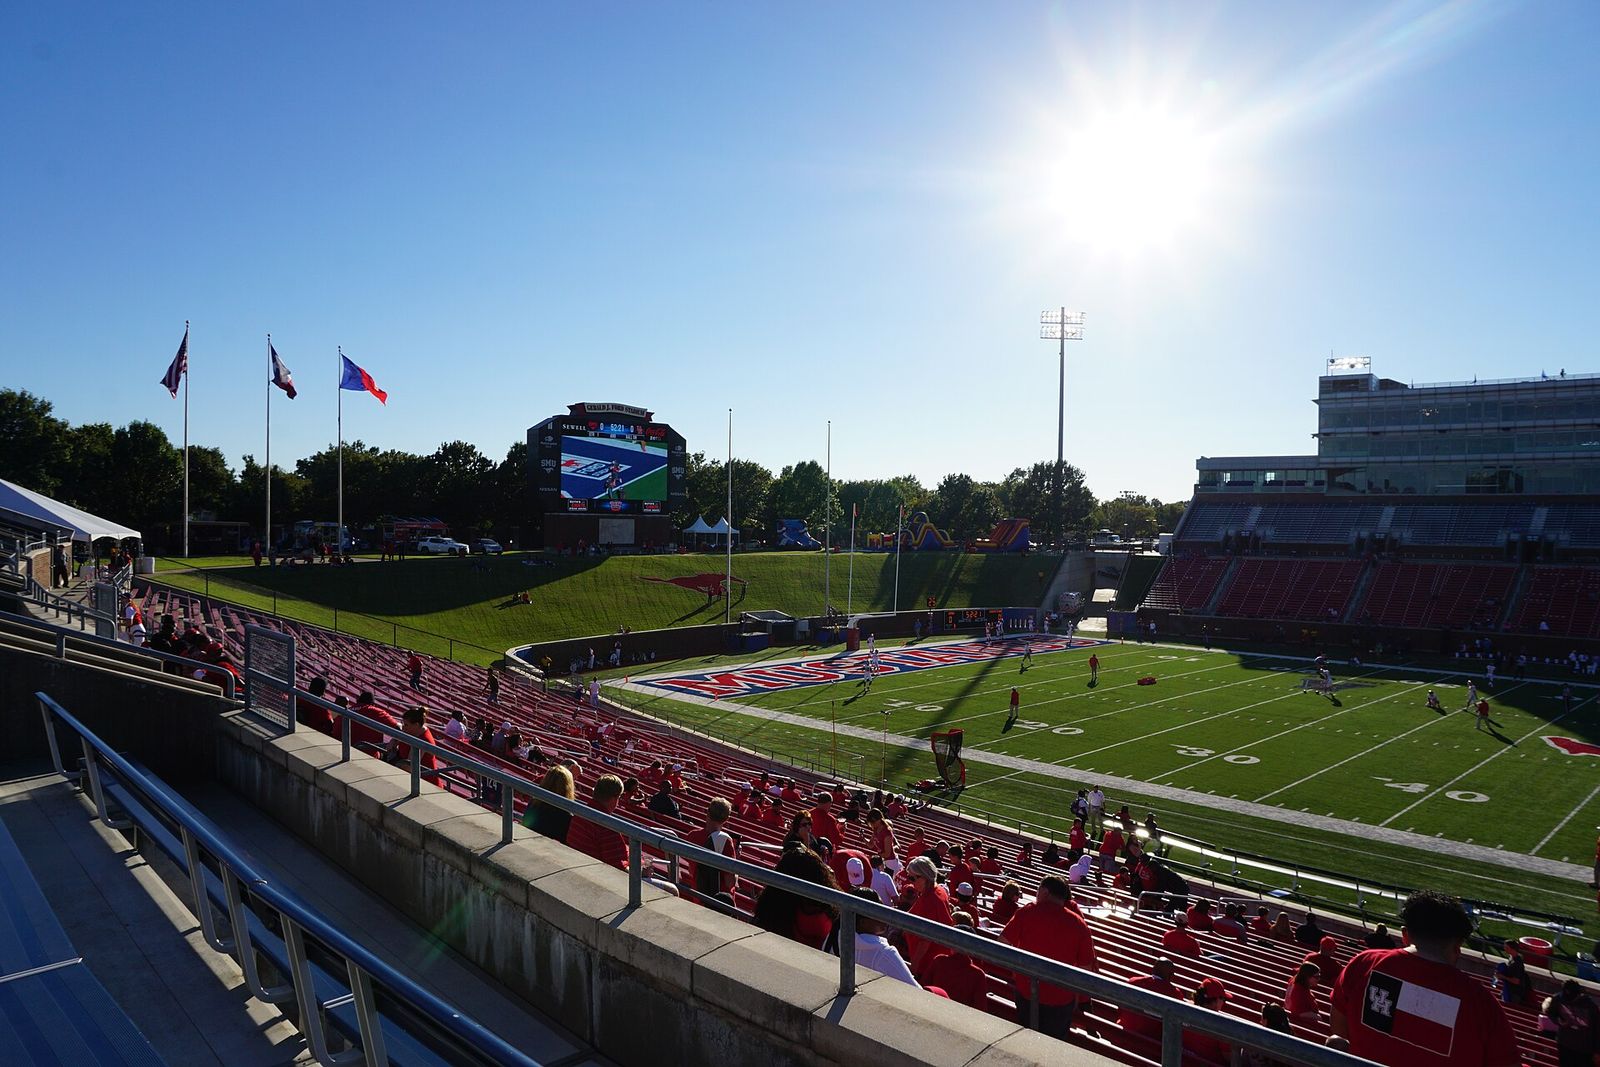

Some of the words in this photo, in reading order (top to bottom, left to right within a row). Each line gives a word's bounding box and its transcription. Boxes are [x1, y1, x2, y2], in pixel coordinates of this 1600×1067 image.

[562, 423, 587, 431] SEWELL
[540, 459, 557, 467] SMU
[742, 803, 750, 816] 7
